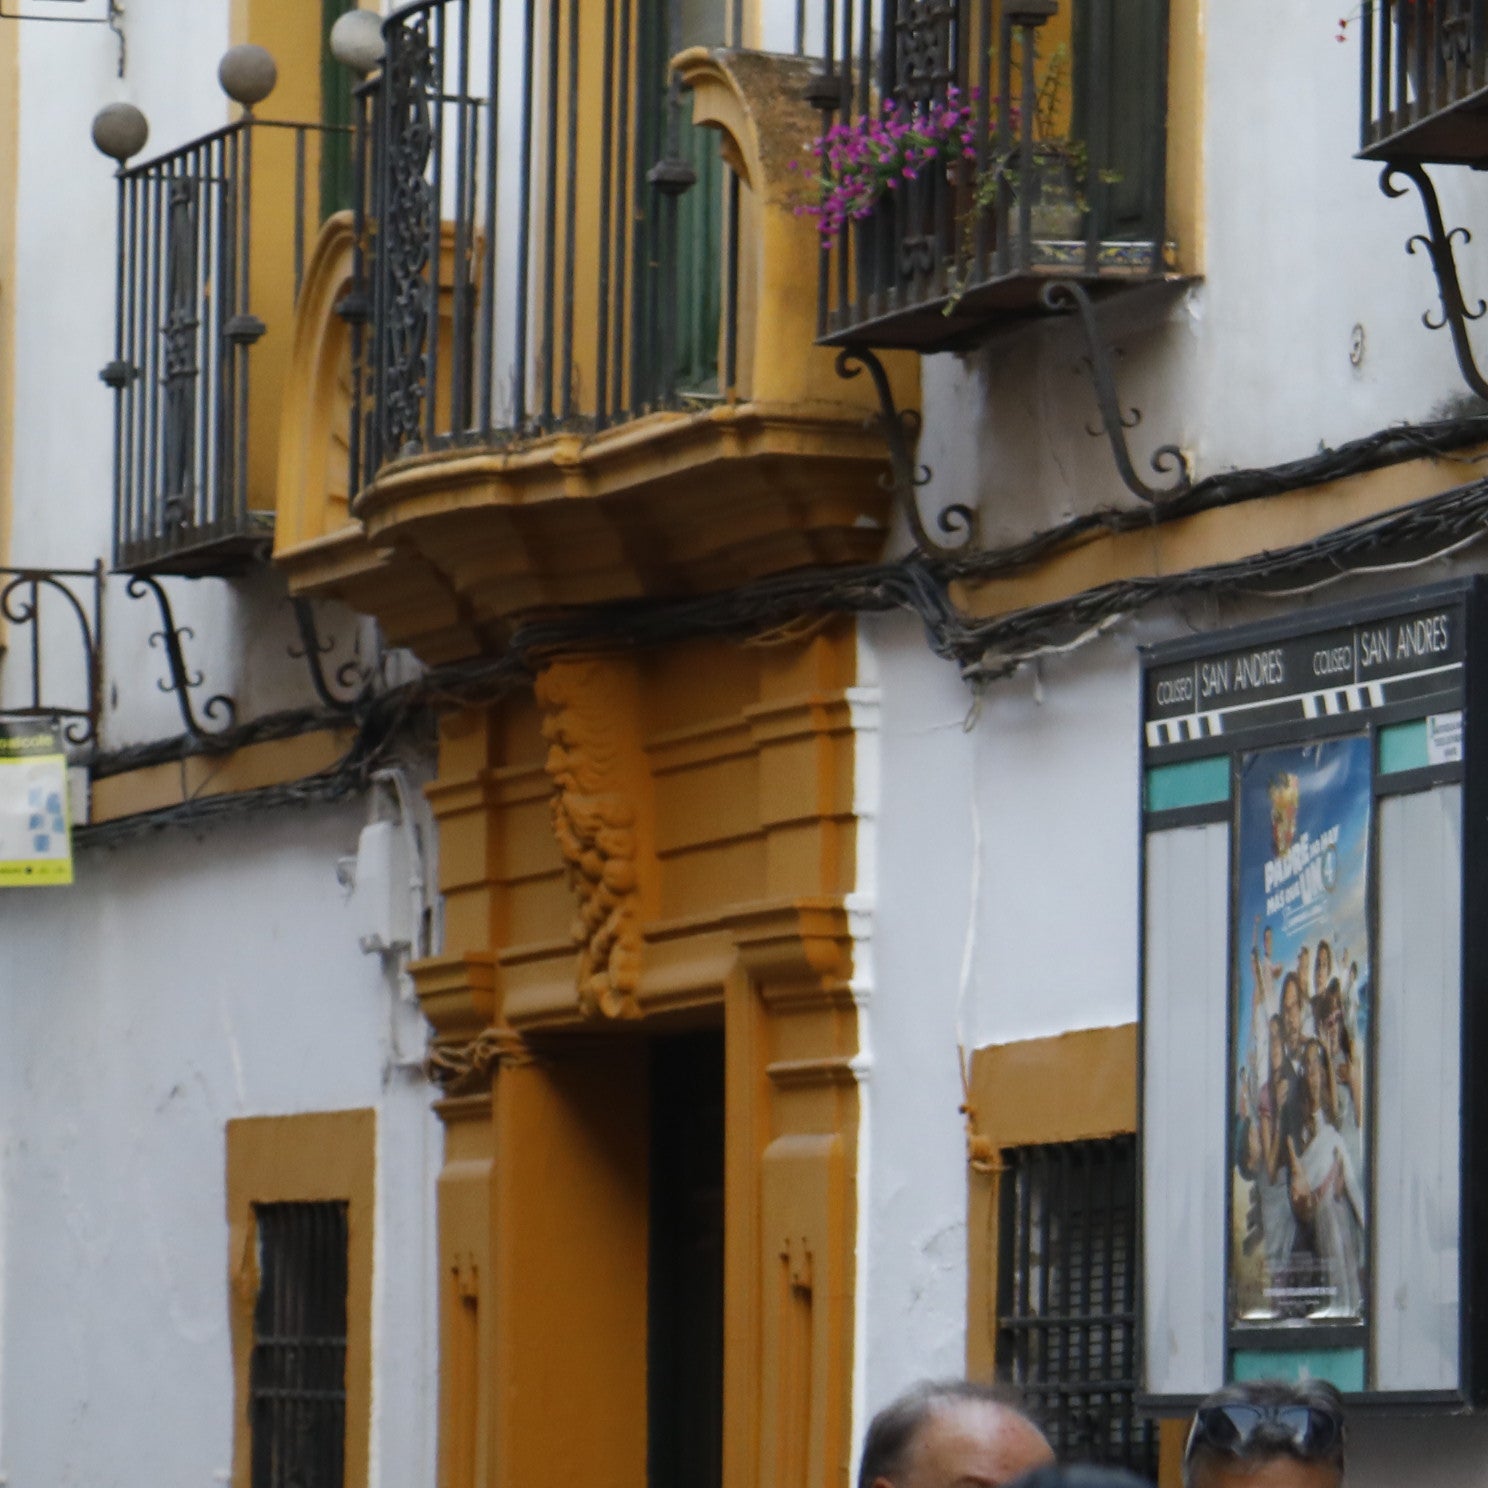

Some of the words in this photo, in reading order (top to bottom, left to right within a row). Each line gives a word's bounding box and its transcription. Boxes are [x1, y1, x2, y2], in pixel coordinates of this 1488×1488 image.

[1312, 646, 1352, 676] COLISEO
[1361, 630, 1390, 667] SAN
[1397, 614, 1449, 660] ANDRES
[1156, 676, 1193, 706] COLISEO
[1201, 659, 1229, 697] SAN
[1233, 649, 1284, 692] ANDRES
